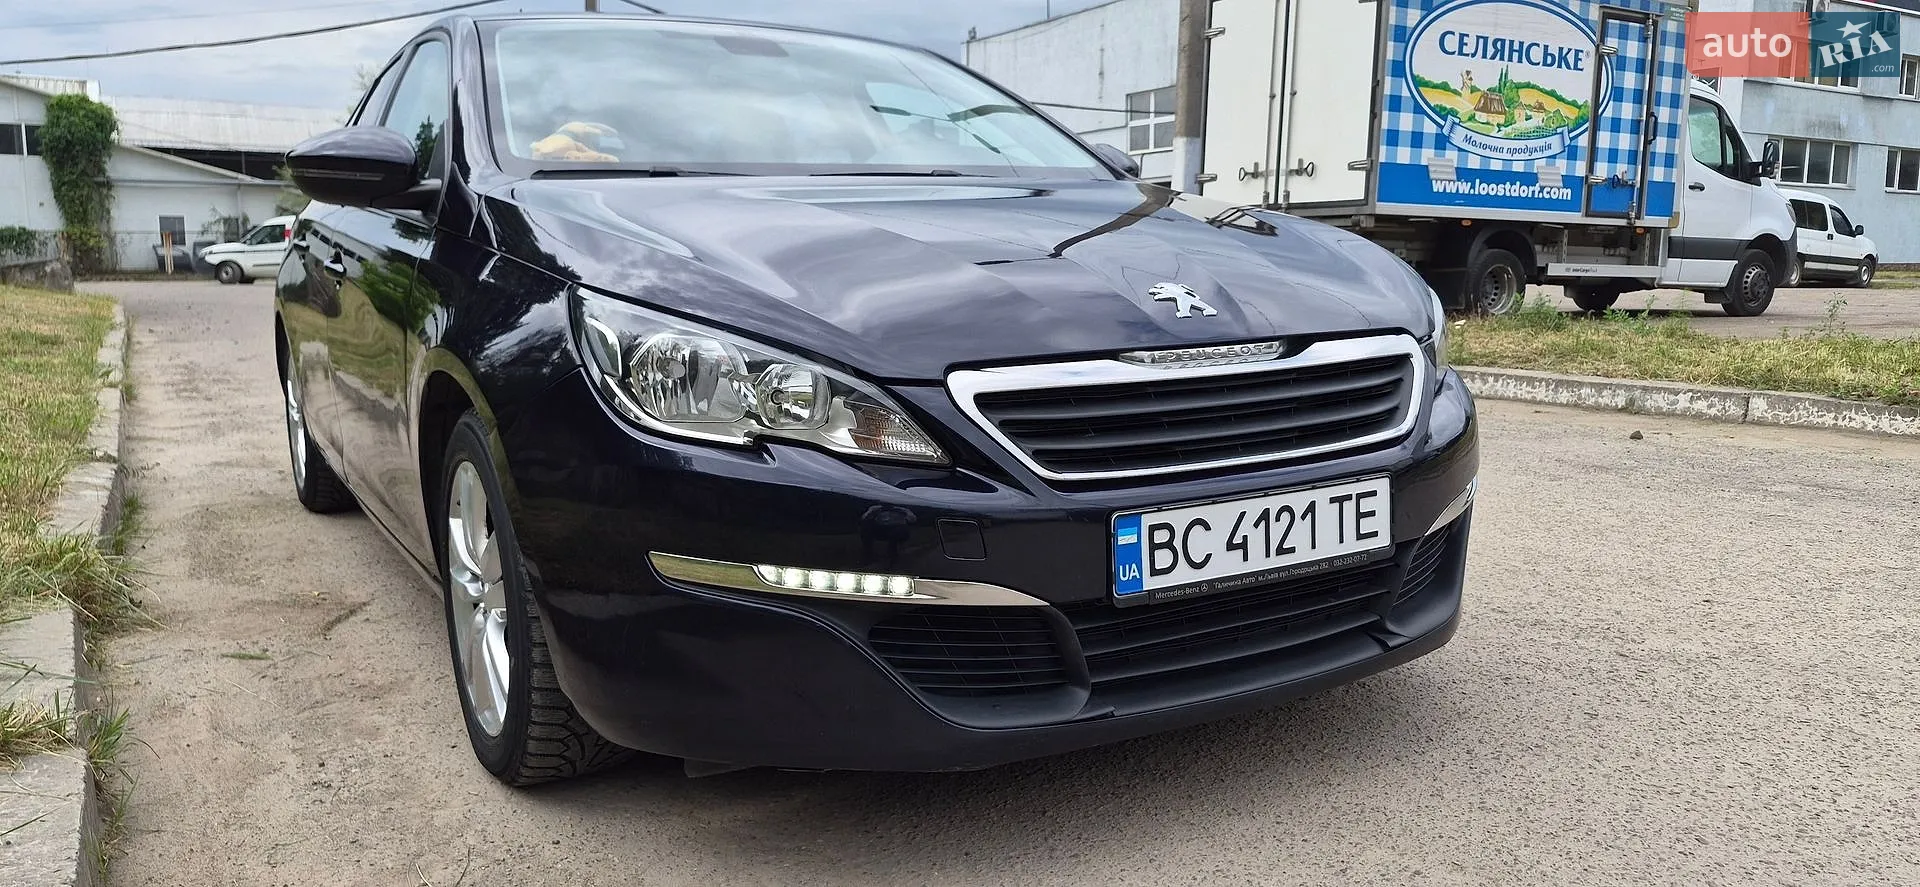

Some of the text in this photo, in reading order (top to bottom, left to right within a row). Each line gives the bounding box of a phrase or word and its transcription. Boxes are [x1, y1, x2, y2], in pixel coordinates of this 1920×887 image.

[1438, 30, 1584, 72] СЕЛЯНСЬКЕ
[1462, 133, 1552, 156] Молочна продукція
[1432, 178, 1572, 200] www.loostdorf.com
[1167, 344, 1265, 362] PEUGEOT
[1148, 490, 1379, 577] BC 4121 TE
[1119, 564, 1140, 582] UA
[1155, 585, 1200, 600] Mercedes-Benz
